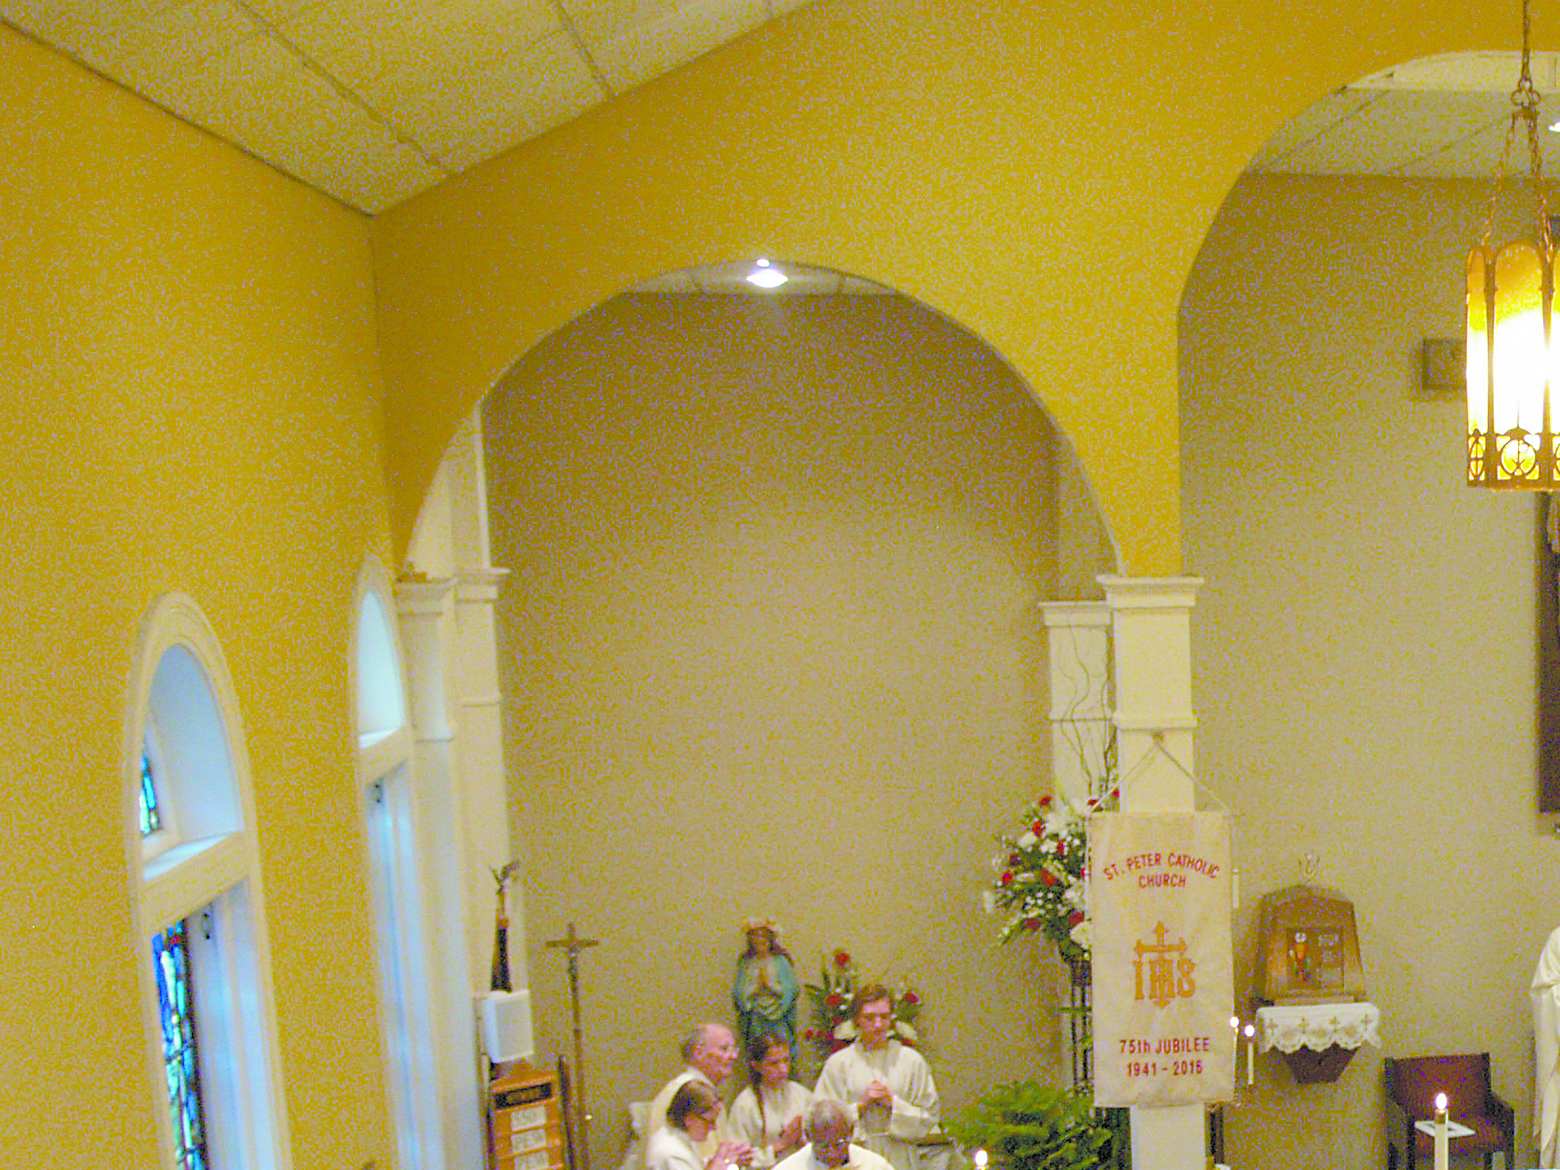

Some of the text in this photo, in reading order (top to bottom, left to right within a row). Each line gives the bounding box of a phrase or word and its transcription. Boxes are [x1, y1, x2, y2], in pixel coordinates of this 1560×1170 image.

[1126, 853, 1161, 871] PETER
[1167, 853, 1220, 878] CATHOLIC
[1138, 874, 1186, 888] CHURCH
[1119, 1037, 1210, 1055] 75th JUBILEE
[1127, 1062, 1156, 1077] 1941
